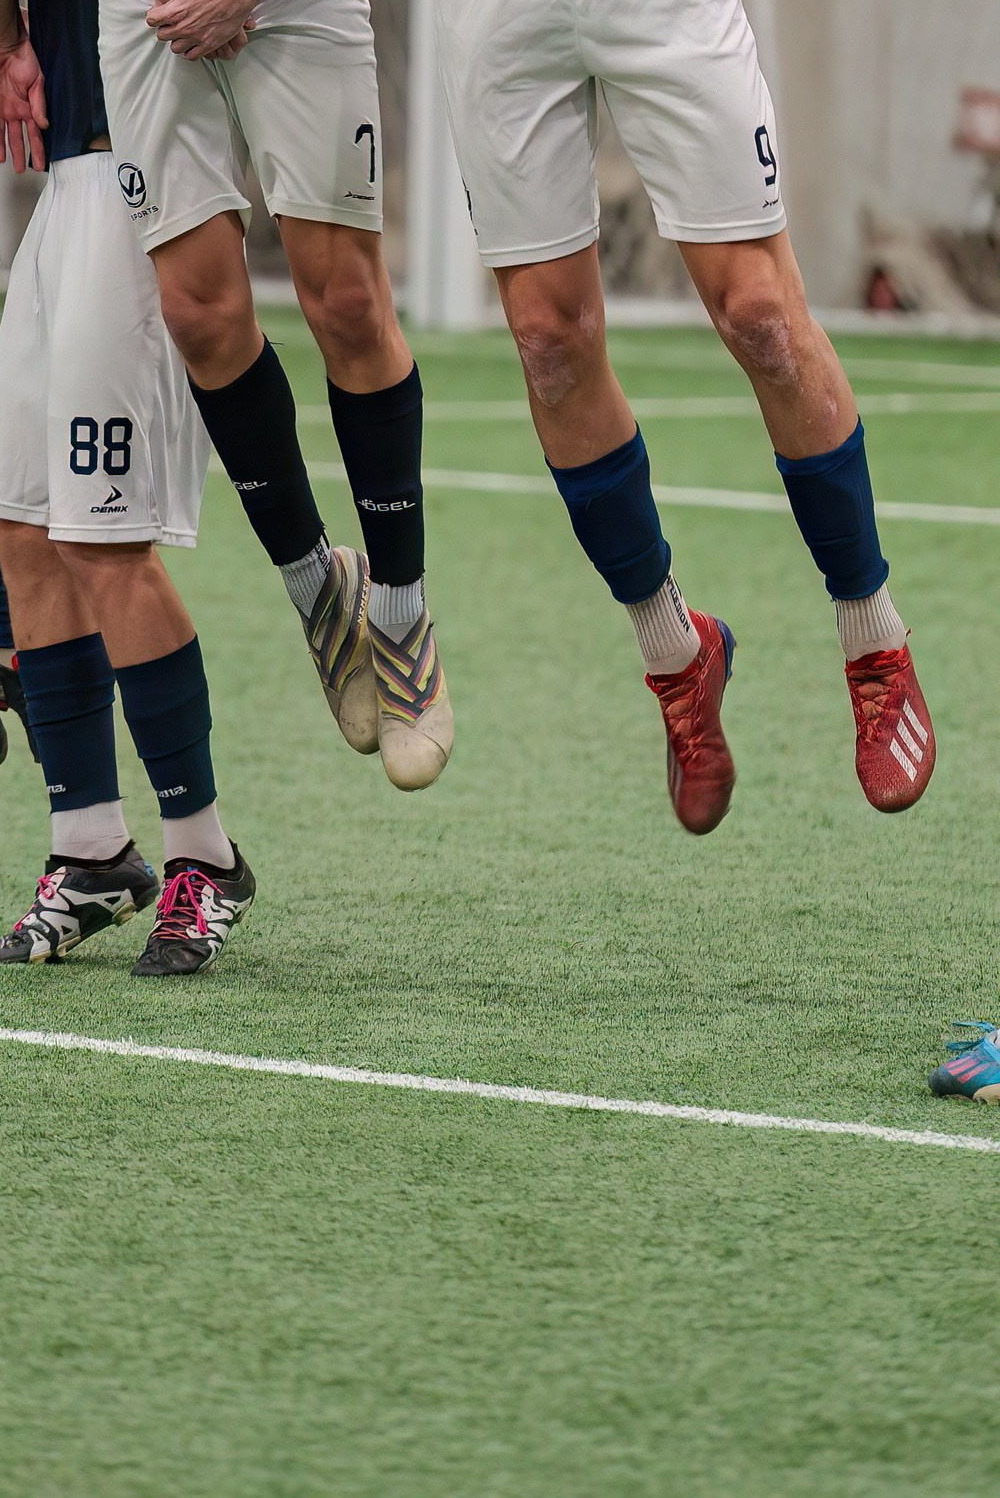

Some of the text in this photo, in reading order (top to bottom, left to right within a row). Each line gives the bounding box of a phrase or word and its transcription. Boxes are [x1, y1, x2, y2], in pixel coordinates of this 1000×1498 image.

[754, 124, 777, 187] 9
[130, 205, 159, 221] SPORTS
[69, 416, 133, 476] 88
[90, 505, 128, 514] DEMIX
